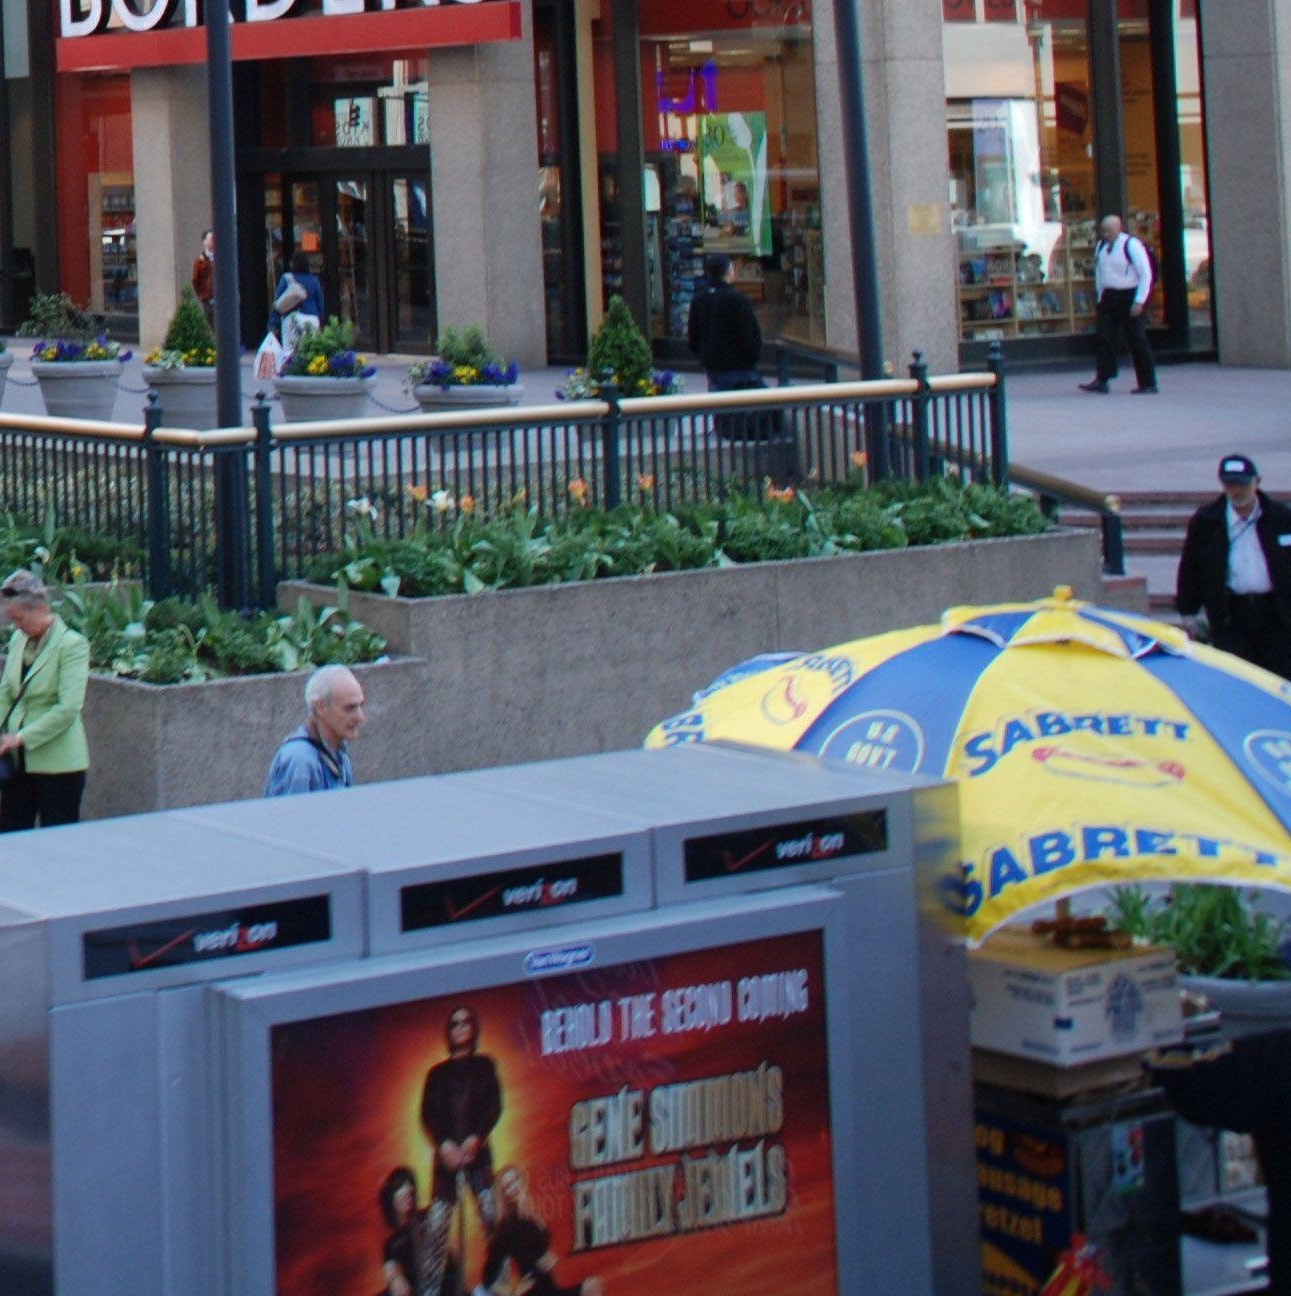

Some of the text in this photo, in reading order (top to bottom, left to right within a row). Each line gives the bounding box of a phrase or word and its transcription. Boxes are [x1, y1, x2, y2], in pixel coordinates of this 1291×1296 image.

[963, 710, 1190, 778] SABRETT
[776, 831, 845, 860] verizon
[502, 877, 578, 906] verizon
[193, 921, 278, 953] verizon
[541, 968, 809, 1056] BEHOLD THE SECOND COMING
[570, 1059, 784, 1171] GENE SIMMONS
[571, 1139, 787, 1254] FAMILY JEWELS
